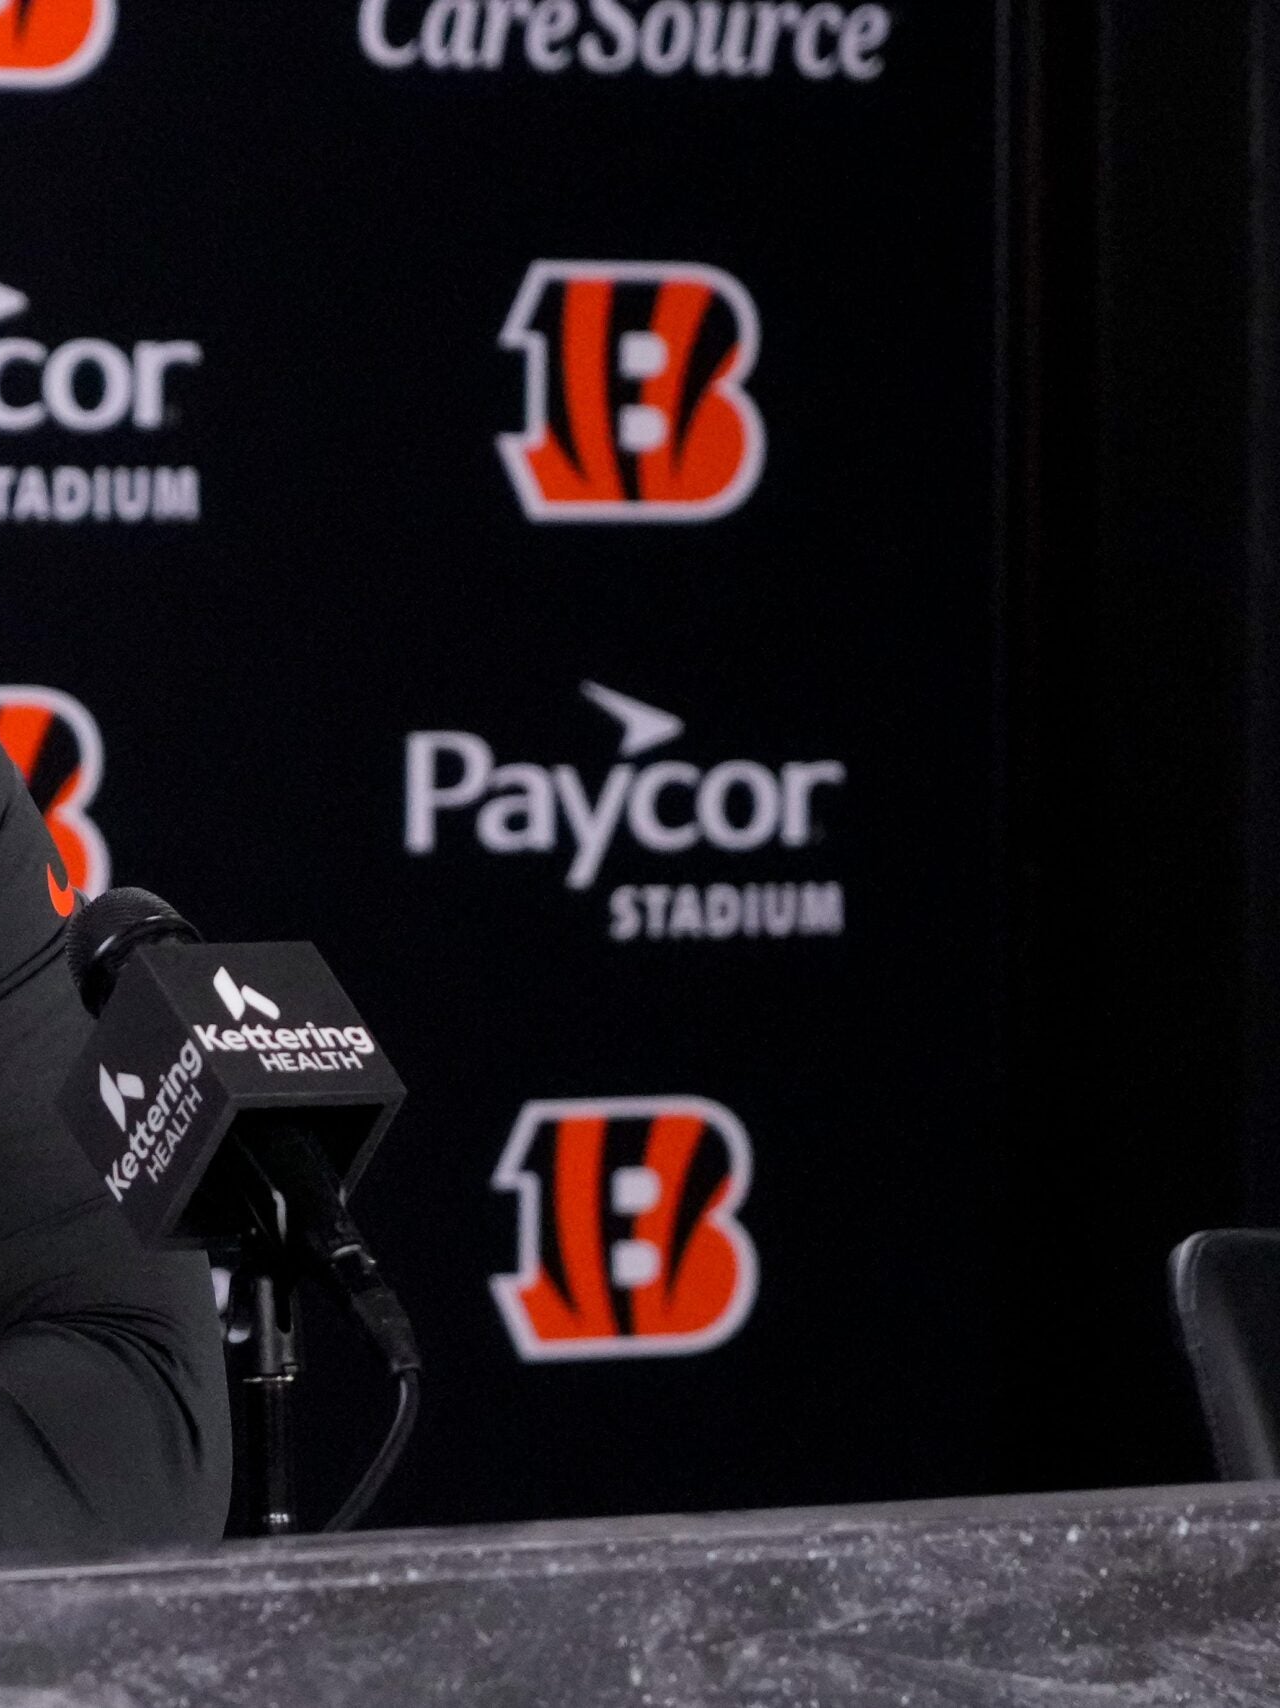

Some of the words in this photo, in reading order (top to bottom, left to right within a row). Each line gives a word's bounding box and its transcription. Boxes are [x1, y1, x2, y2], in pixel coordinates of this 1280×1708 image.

[357, 0, 891, 80] CareSource
[403, 729, 847, 892] Paycor
[608, 880, 845, 943] STADIUM
[192, 1021, 376, 1055] Kettering
[258, 1050, 364, 1073] HEALTH
[103, 1037, 204, 1203] Kettering
[146, 1083, 204, 1184] HEALTH
